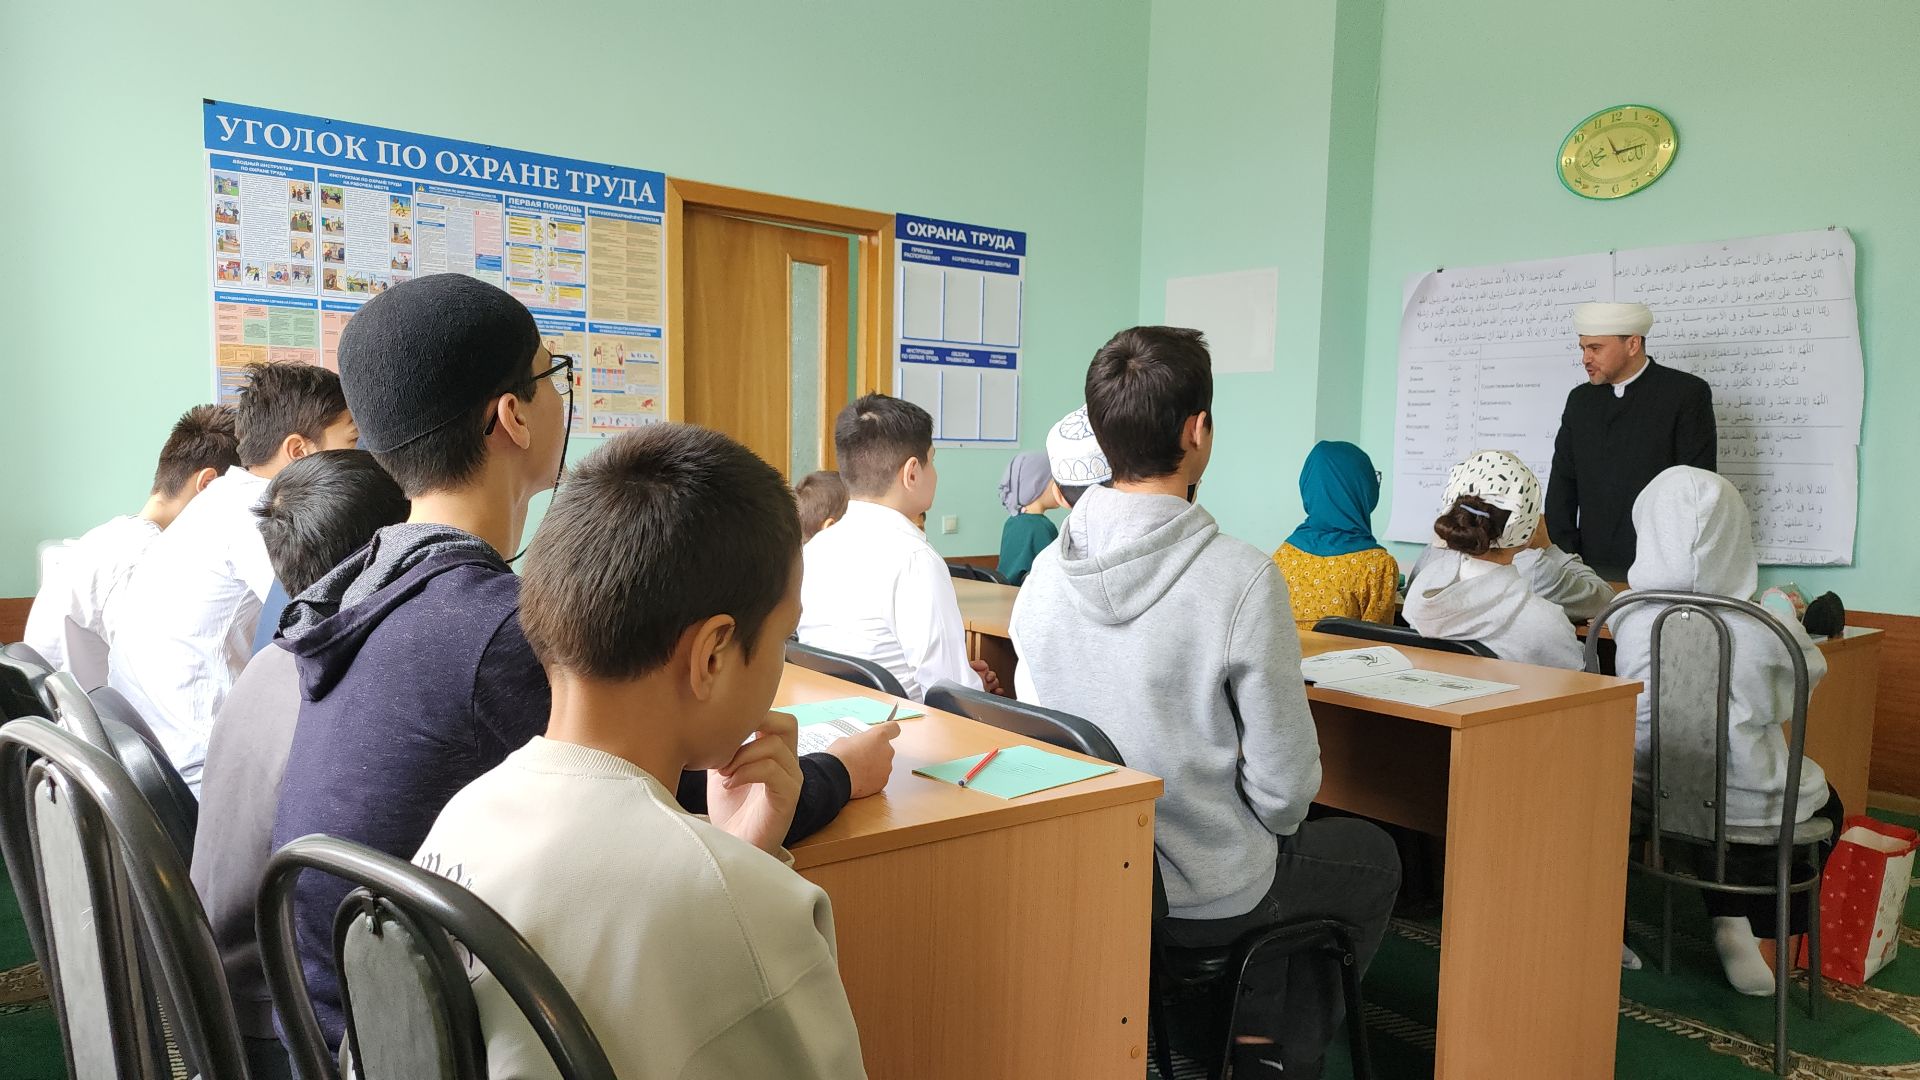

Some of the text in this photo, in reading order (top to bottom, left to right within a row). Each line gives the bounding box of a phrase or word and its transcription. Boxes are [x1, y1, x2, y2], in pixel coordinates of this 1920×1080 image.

[1610, 111, 1623, 123] 12
[1594, 119, 1602, 129] 11
[1574, 132, 1585, 144] 10
[1663, 138, 1672, 149] 3
[216, 115, 656, 205] УГОЛОК ПО ОХРАНЕ ТРУДА
[1594, 185, 1600, 194] 7
[1612, 183, 1620, 194] 6
[508, 197, 542, 208] ПЕРВАЯ
[543, 202, 582, 214] ПОМОЩЬ
[906, 221, 1016, 251] ОХРАНА ТРУДА
